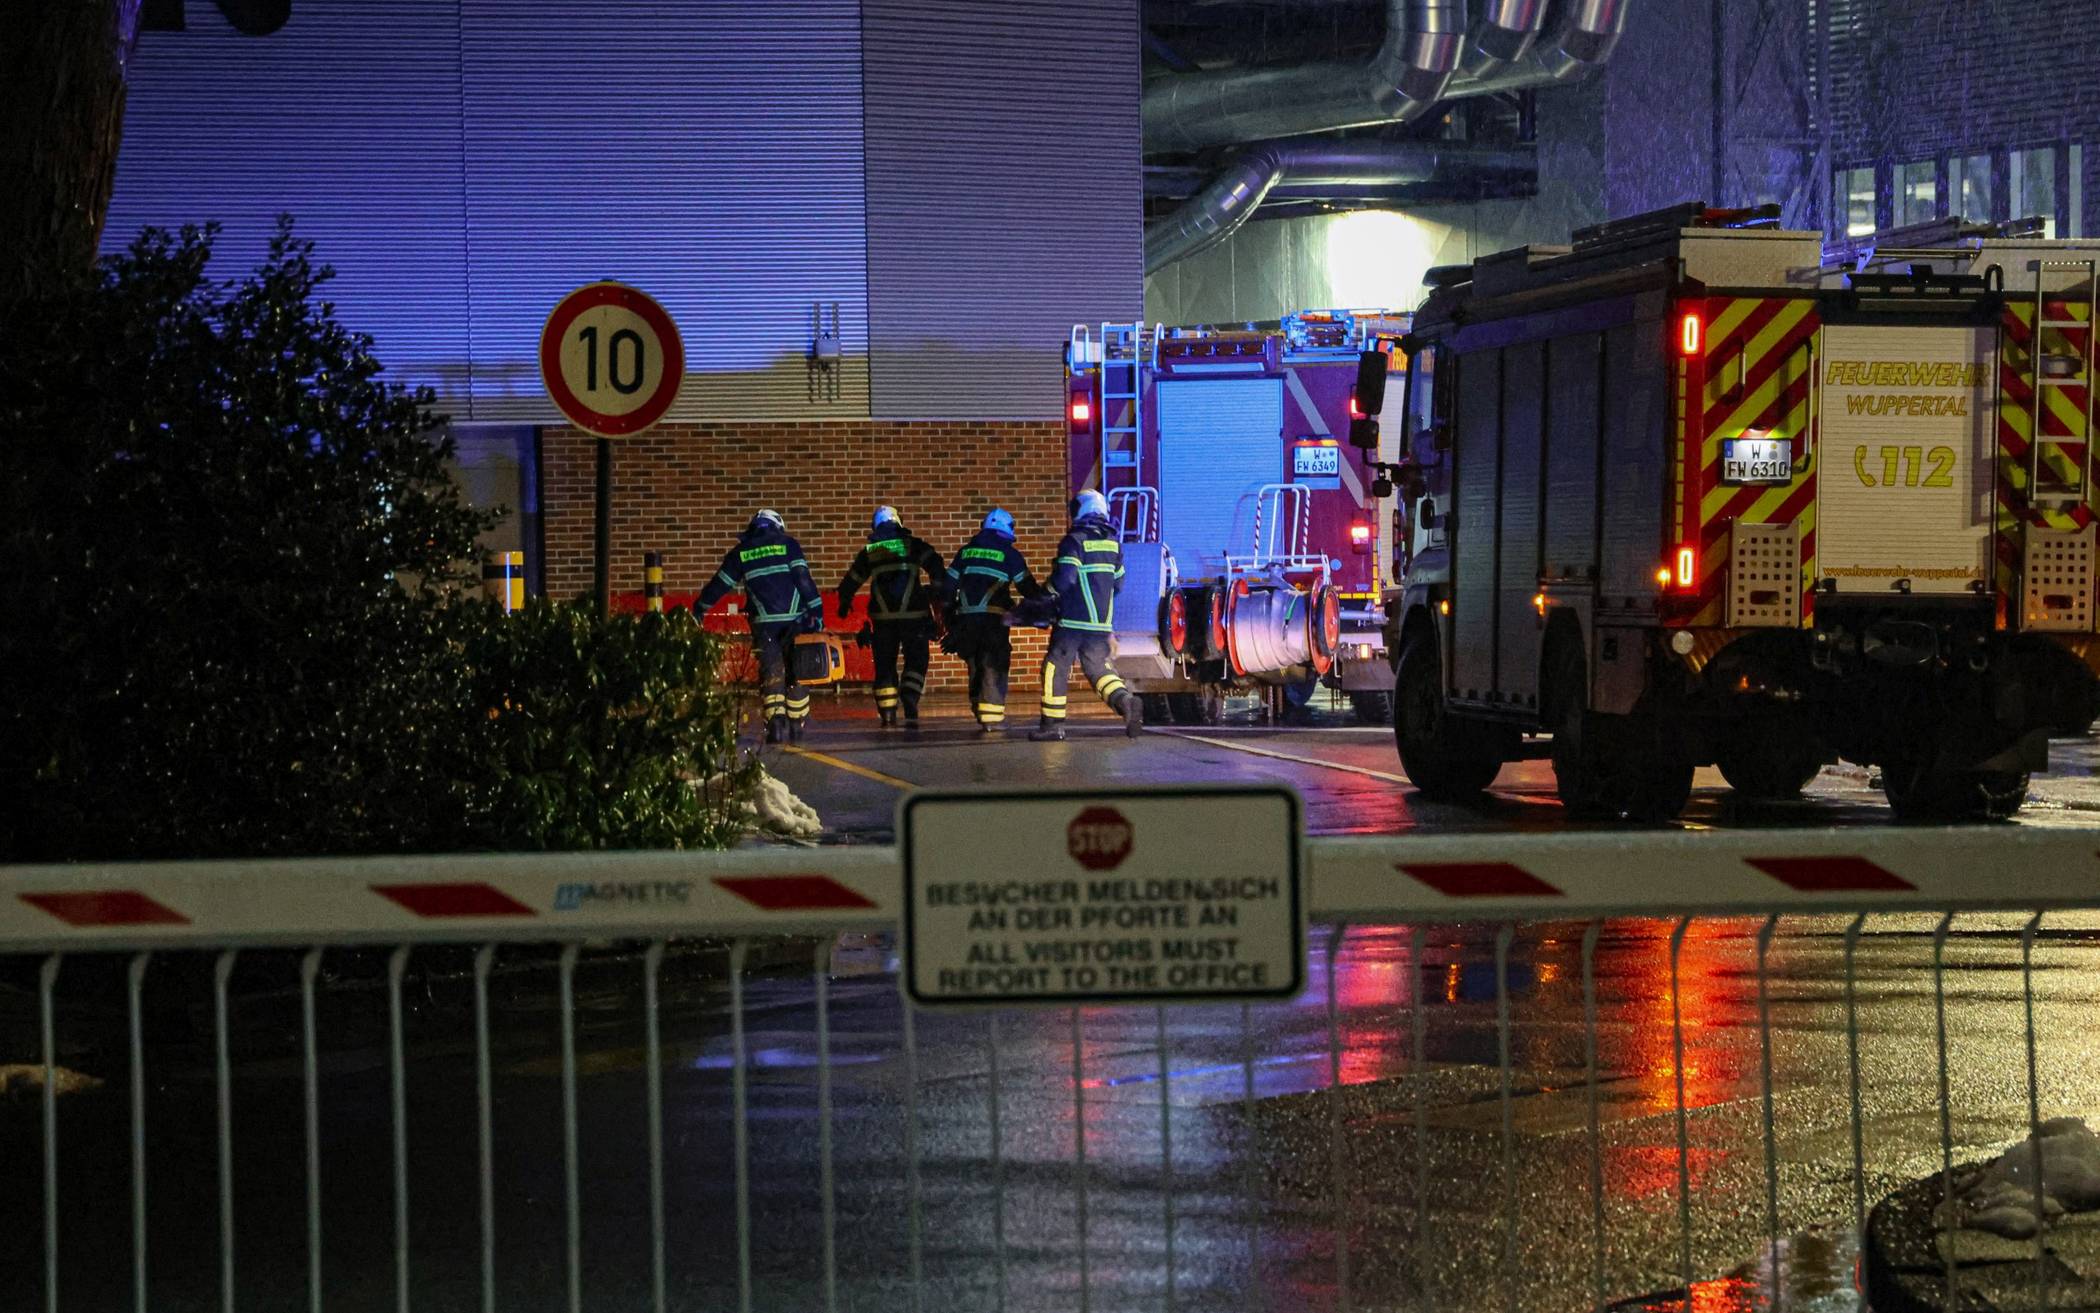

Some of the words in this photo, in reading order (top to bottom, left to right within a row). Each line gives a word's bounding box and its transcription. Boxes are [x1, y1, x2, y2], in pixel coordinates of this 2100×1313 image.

[579, 326, 645, 395] 10
[1826, 360, 1991, 387] FEUERWEHR
[1847, 394, 1968, 417] WUPPERTAL
[1313, 449, 1321, 460] W
[1751, 443, 1762, 459] W
[1296, 460, 1309, 472] FW
[1311, 460, 1336, 472] 6349
[1728, 461, 1747, 477] FW
[1751, 461, 1787, 477] 6310
[1880, 445, 1956, 487] 112
[1070, 823, 1127, 855] STOP
[926, 880, 1080, 907] BESUCHER
[1088, 878, 1203, 902] MELDEN
[1210, 876, 1280, 900] SICH
[966, 908, 1007, 931] AN
[1016, 906, 1072, 930] DER
[1080, 904, 1190, 929] PFORTE
[1199, 902, 1238, 927] AN
[965, 941, 1018, 964] ALL
[1024, 938, 1153, 963] VISITORS
[1161, 936, 1239, 961] MUST
[938, 967, 1050, 993] REPORT
[1060, 965, 1099, 990] TO
[1107, 963, 1158, 988] THE
[1167, 961, 1267, 986] OFFICE
